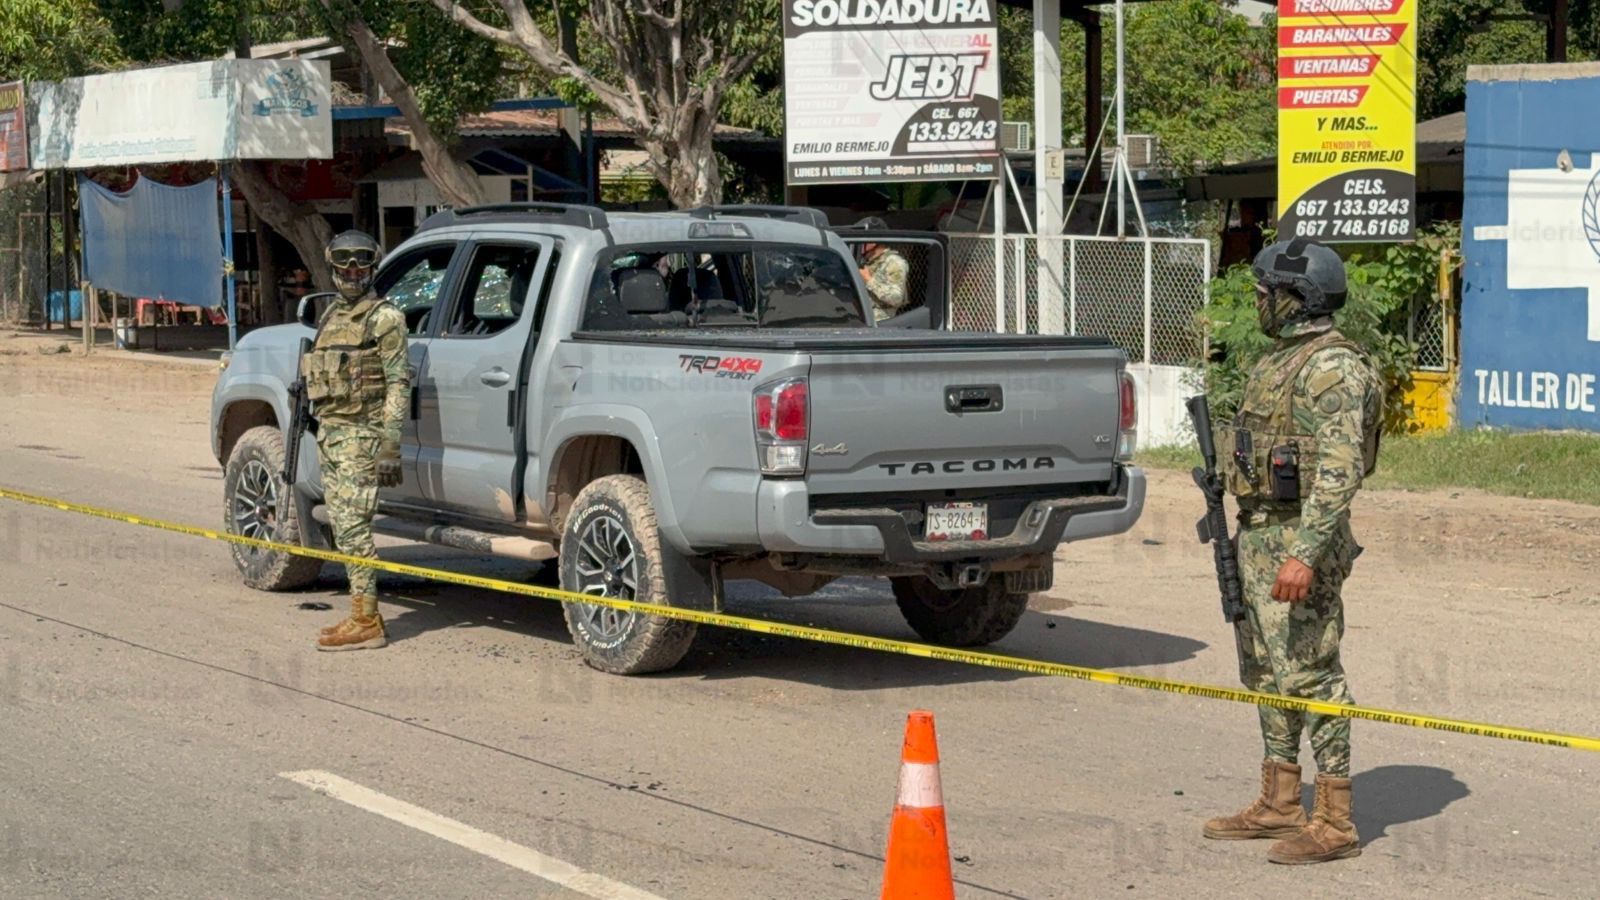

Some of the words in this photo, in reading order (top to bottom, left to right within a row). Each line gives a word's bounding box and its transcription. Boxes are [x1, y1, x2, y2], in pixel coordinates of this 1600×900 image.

[791, 0, 992, 26] SOLDADURA
[1293, 0, 1394, 13] TECHUMBRES
[1292, 27, 1392, 44] BARANDALES
[1293, 59, 1370, 74] VENTANAS
[869, 51, 990, 101] JEBT
[1293, 89, 1359, 104] PUERTAS
[932, 107, 953, 119] CEL.
[957, 107, 979, 119] 667
[908, 120, 997, 141] 133.9243
[1316, 117, 1328, 131] Y
[1330, 116, 1379, 131] MAS...
[792, 142, 832, 154] EMILIO
[835, 141, 890, 153] BERMEJO
[1292, 151, 1337, 164] EMILIO
[1341, 150, 1404, 163] BERMEJO
[794, 167, 820, 177] LUNES
[821, 167, 829, 176] A
[829, 166, 863, 176] VIERNES
[923, 162, 955, 174] SÁBADO
[1343, 179, 1387, 195] CELS.
[1296, 201, 1327, 216] 667
[1333, 199, 1410, 215] 133.9243
[1296, 220, 1327, 236] 667
[1332, 219, 1410, 235] 748.6168
[678, 354, 721, 374] TRD
[714, 370, 757, 381] SPORT
[1475, 369, 1560, 409] TALLER
[1565, 372, 1596, 412] DE
[878, 456, 1055, 476] TACOMA
[928, 511, 986, 530] TS-8264-A
